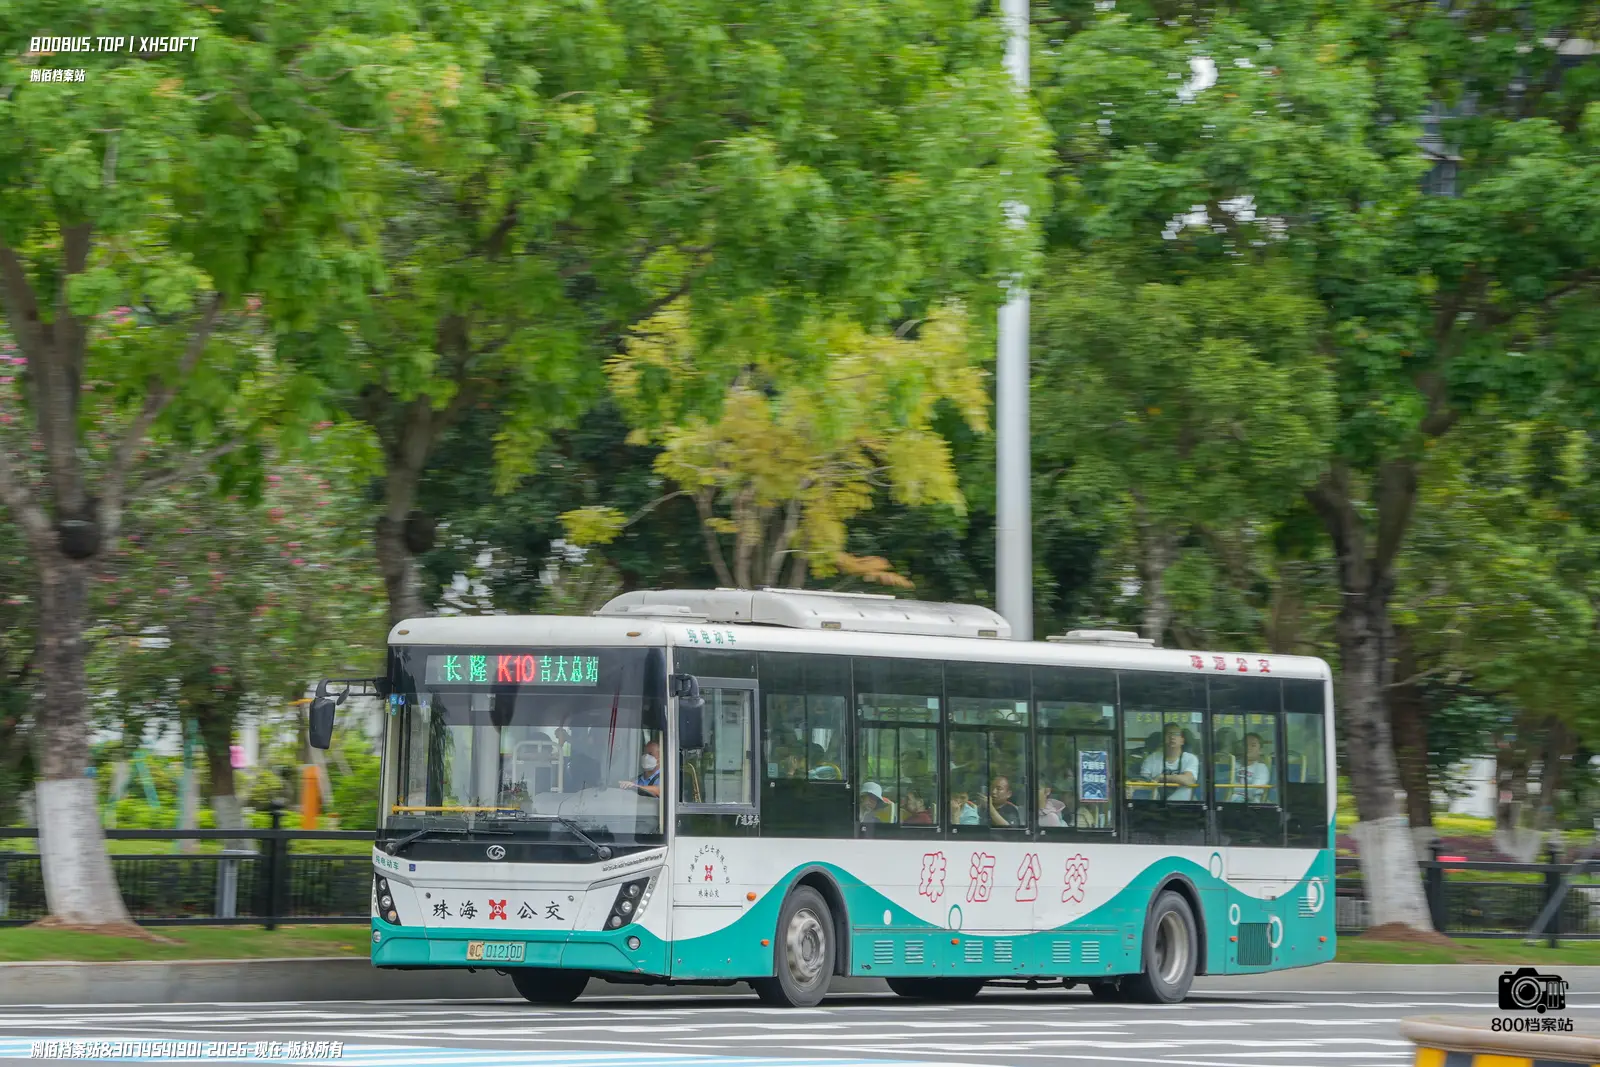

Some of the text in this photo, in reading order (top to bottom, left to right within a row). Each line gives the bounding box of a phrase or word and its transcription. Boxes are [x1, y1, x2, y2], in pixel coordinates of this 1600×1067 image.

[443, 654, 599, 683] 长隆 K10 吉大总站
[919, 851, 1090, 903] 珠海公交
